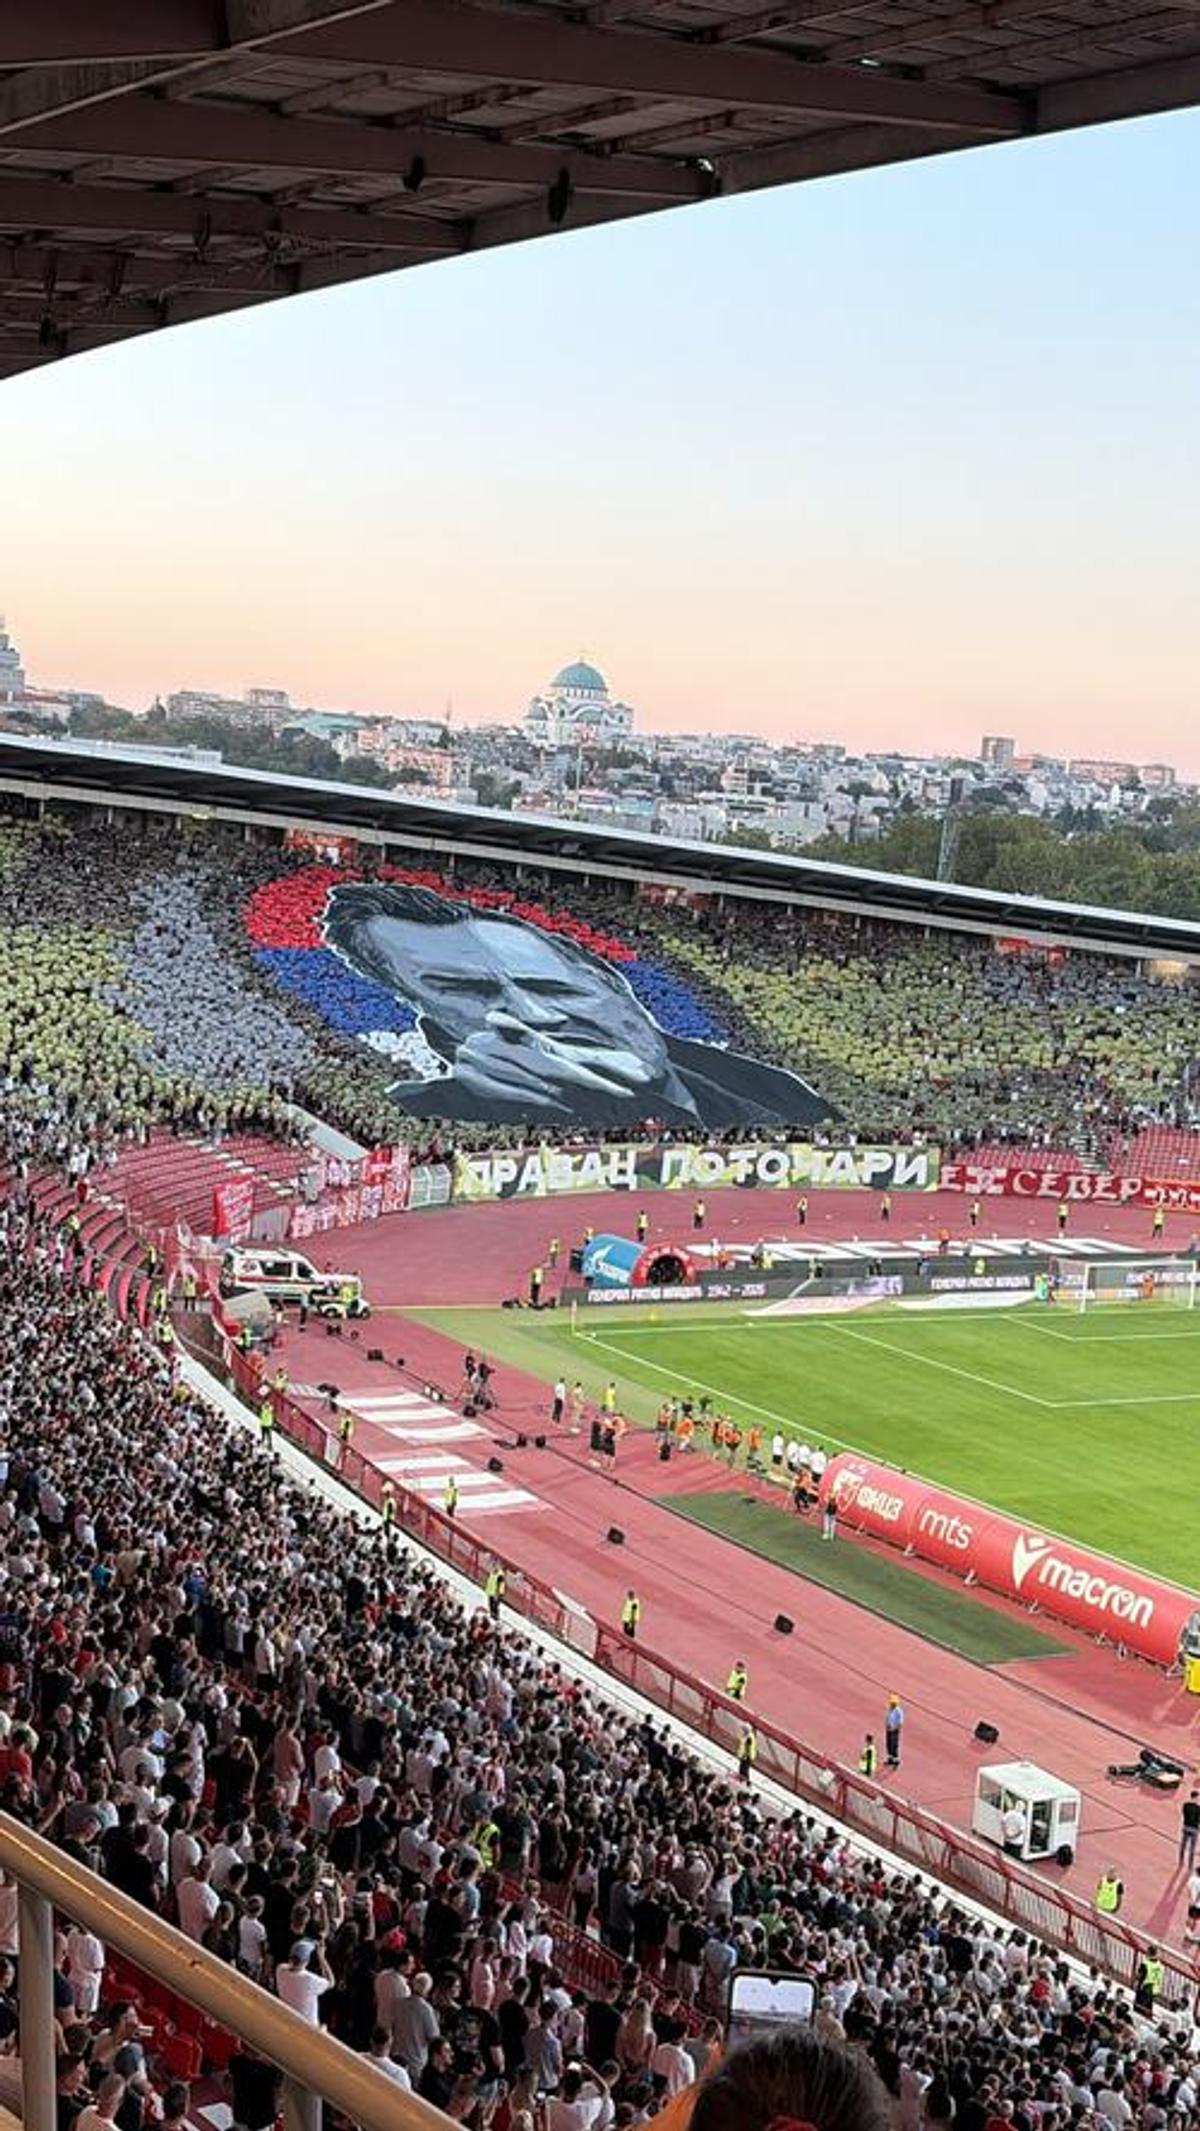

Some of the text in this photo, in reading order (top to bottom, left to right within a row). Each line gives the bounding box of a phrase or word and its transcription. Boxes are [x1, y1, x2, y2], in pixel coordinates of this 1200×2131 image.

[1013, 1171, 1142, 1202] СЕВЕР
[919, 1509, 974, 1549] mts
[1038, 1557, 1154, 1628] macron
